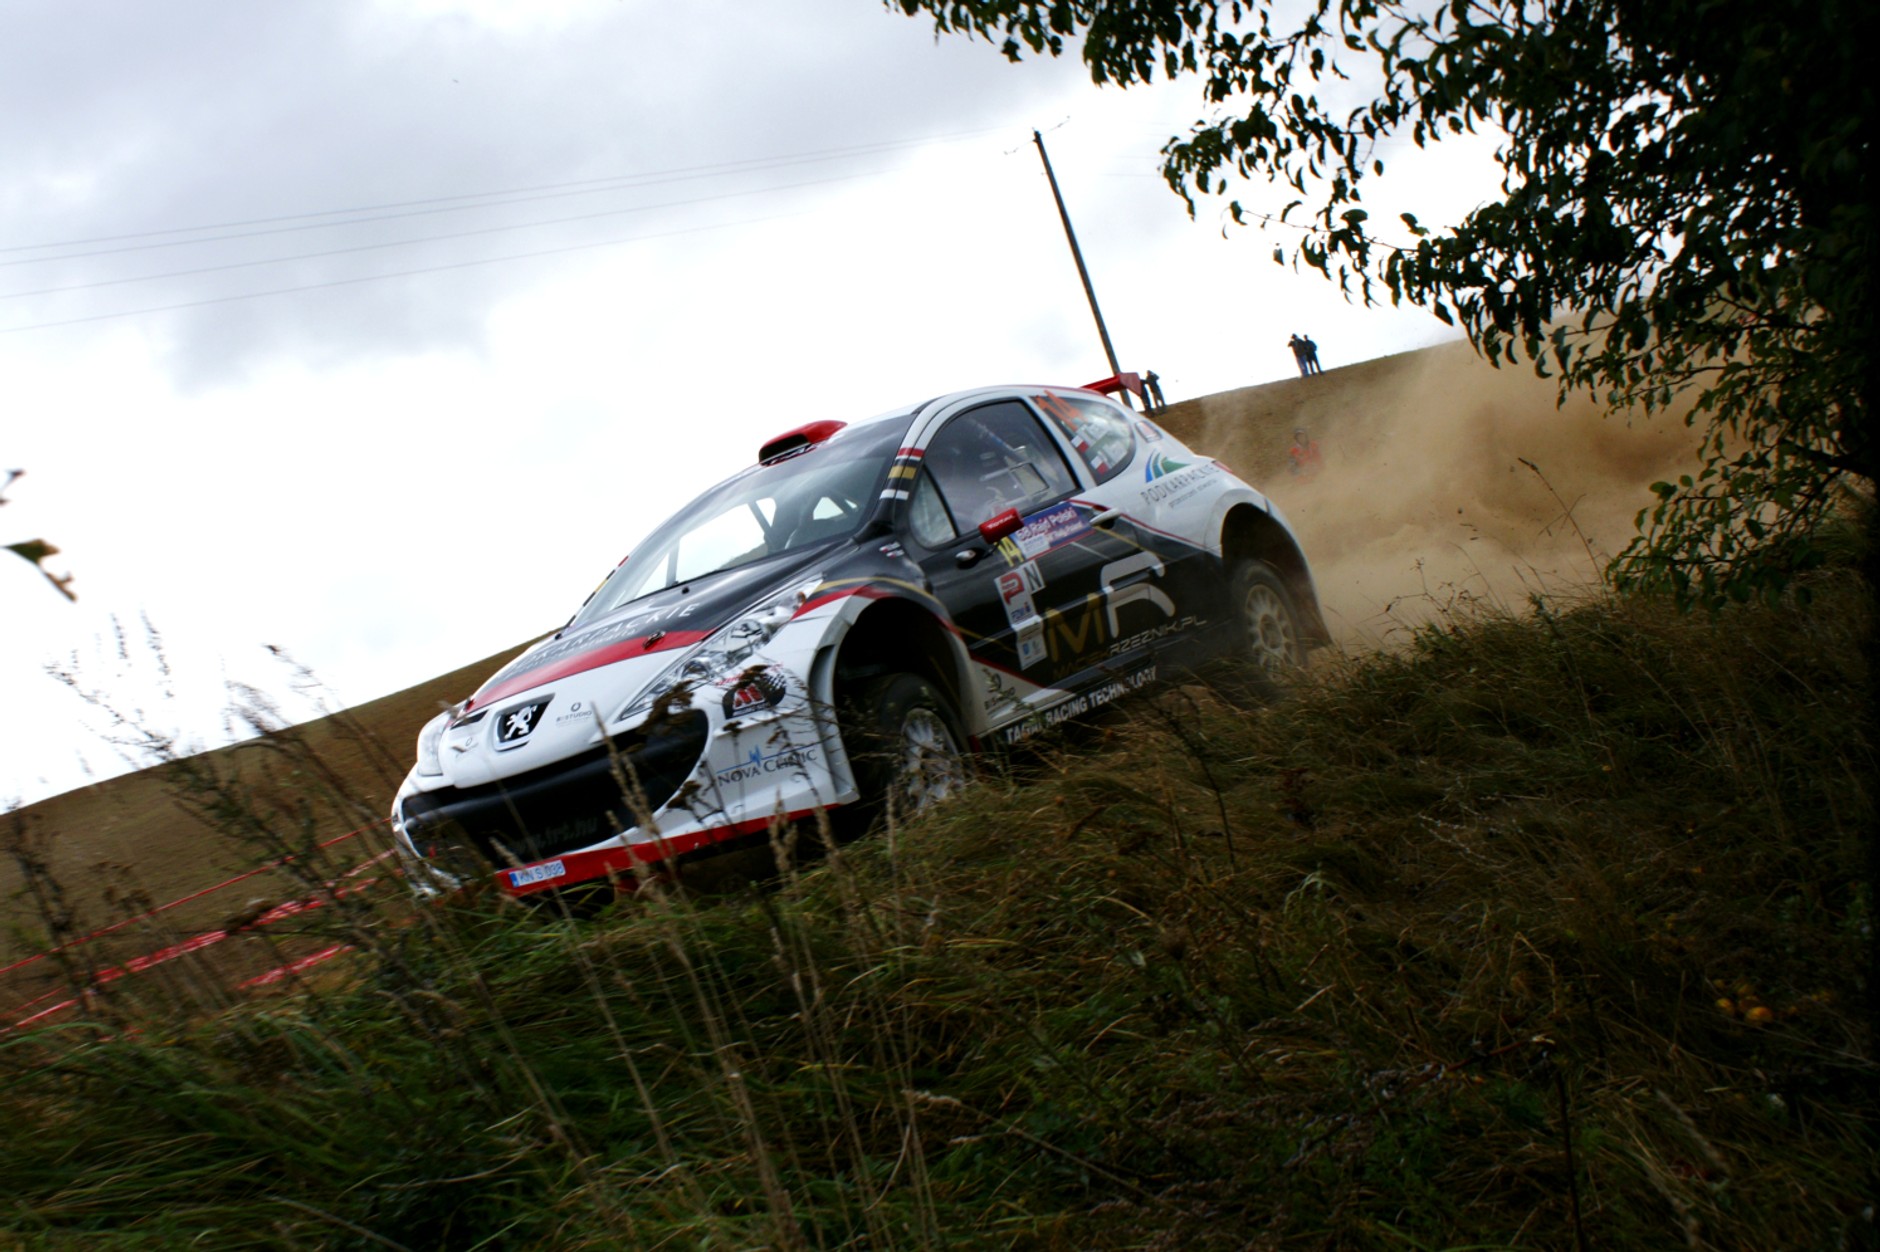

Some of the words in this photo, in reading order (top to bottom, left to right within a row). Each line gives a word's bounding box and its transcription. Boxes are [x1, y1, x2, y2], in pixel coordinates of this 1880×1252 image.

[993, 536, 1025, 567] 14
[1045, 697, 1088, 727] RACING
[717, 766, 762, 787] NOVA
